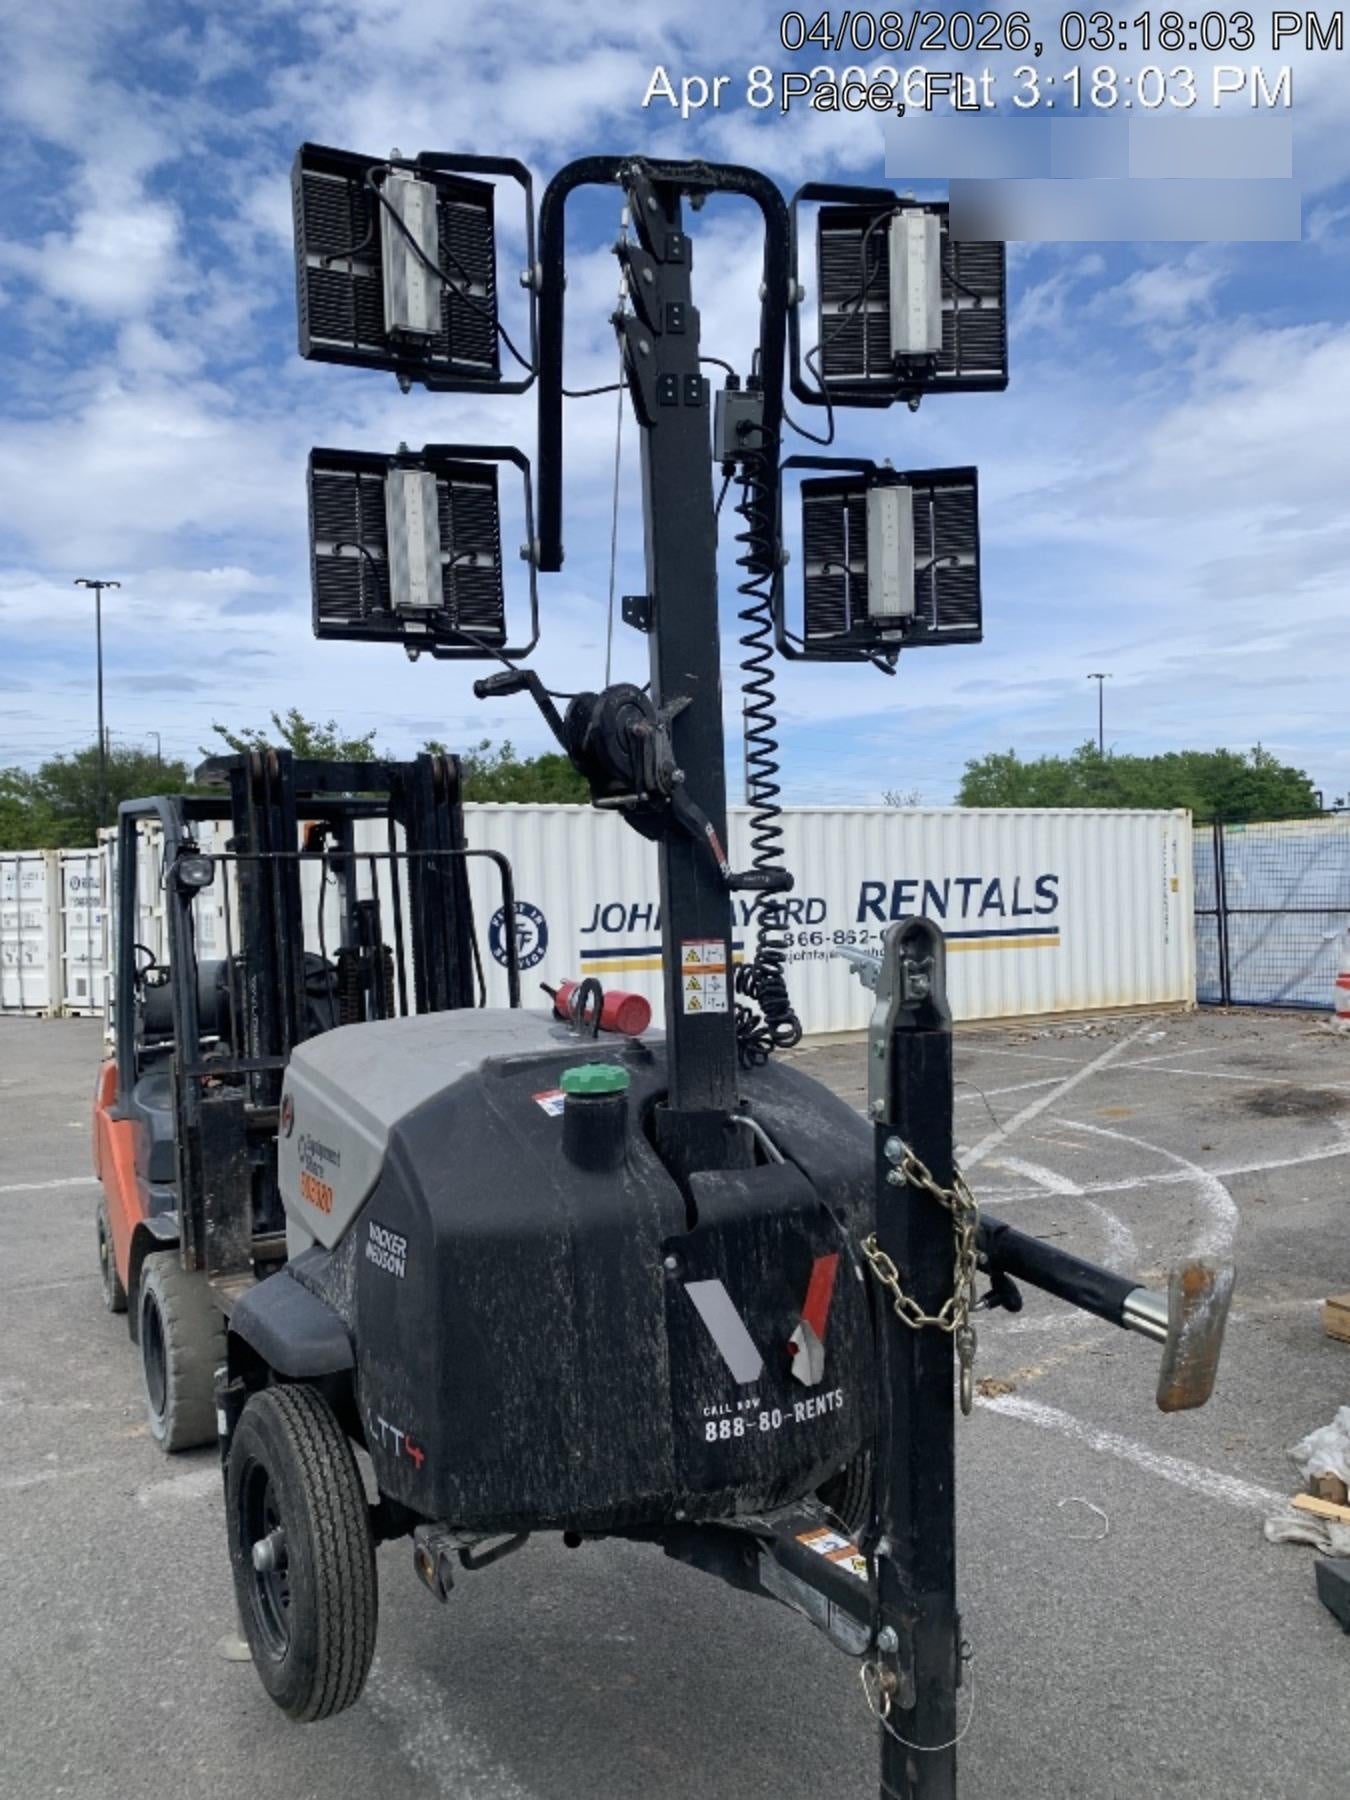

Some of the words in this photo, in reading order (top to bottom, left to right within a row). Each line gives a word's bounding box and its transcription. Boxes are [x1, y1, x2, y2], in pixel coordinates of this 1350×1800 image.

[856, 873, 1059, 923] RENTALS
[703, 1403, 733, 1417] CALL
[705, 1388, 844, 1442] 888-80-RENTS
